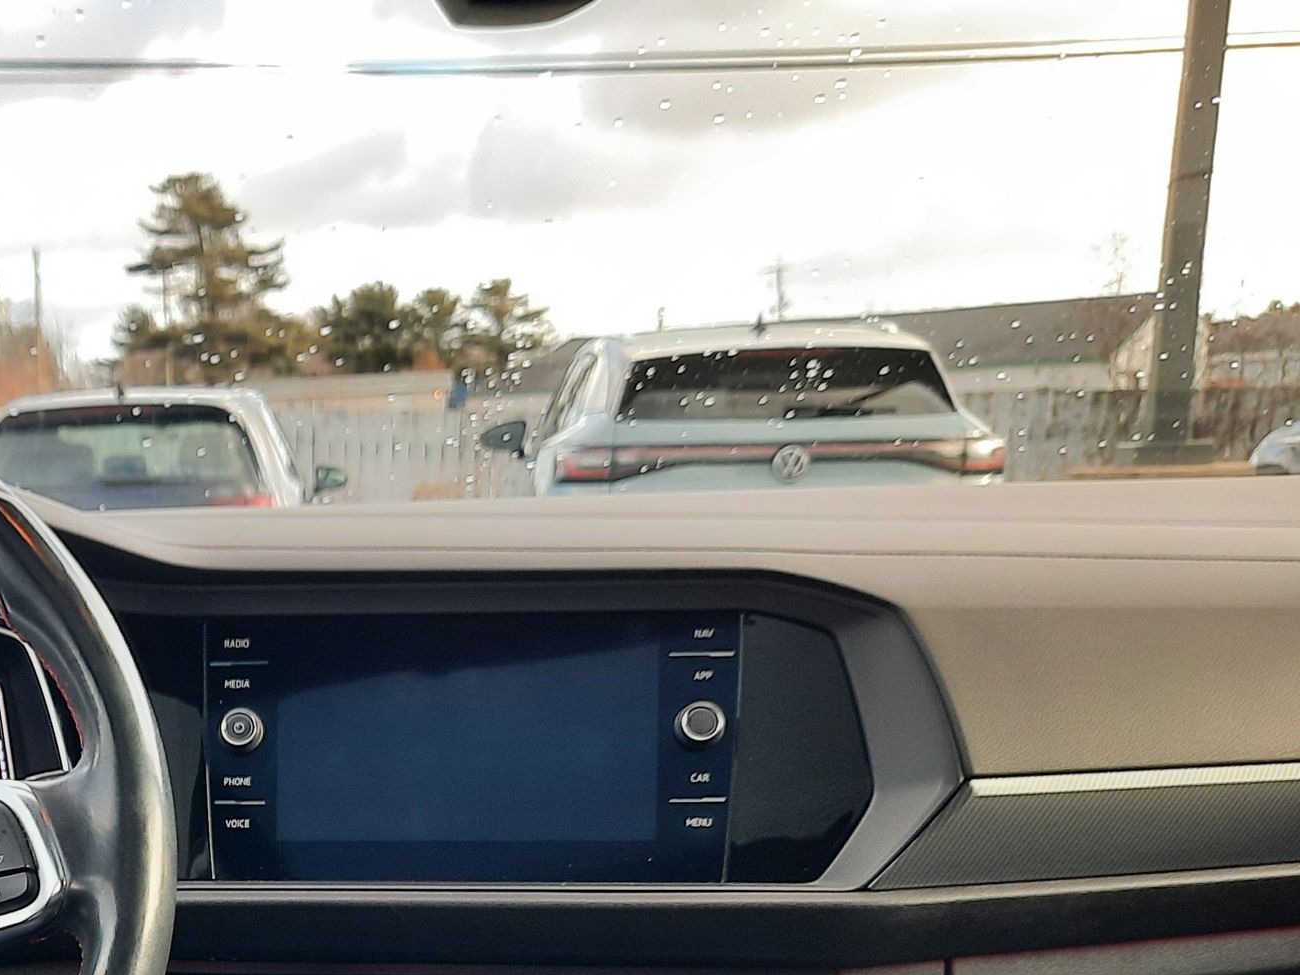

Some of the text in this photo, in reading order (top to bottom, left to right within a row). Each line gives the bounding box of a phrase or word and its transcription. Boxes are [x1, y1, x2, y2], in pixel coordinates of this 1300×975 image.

[223, 638, 251, 649] RADIO
[223, 678, 251, 689] MEDIA
[223, 776, 251, 787] PHONE
[690, 772, 711, 783] CAR
[225, 818, 251, 829] VOICE
[685, 816, 714, 828] MENU
